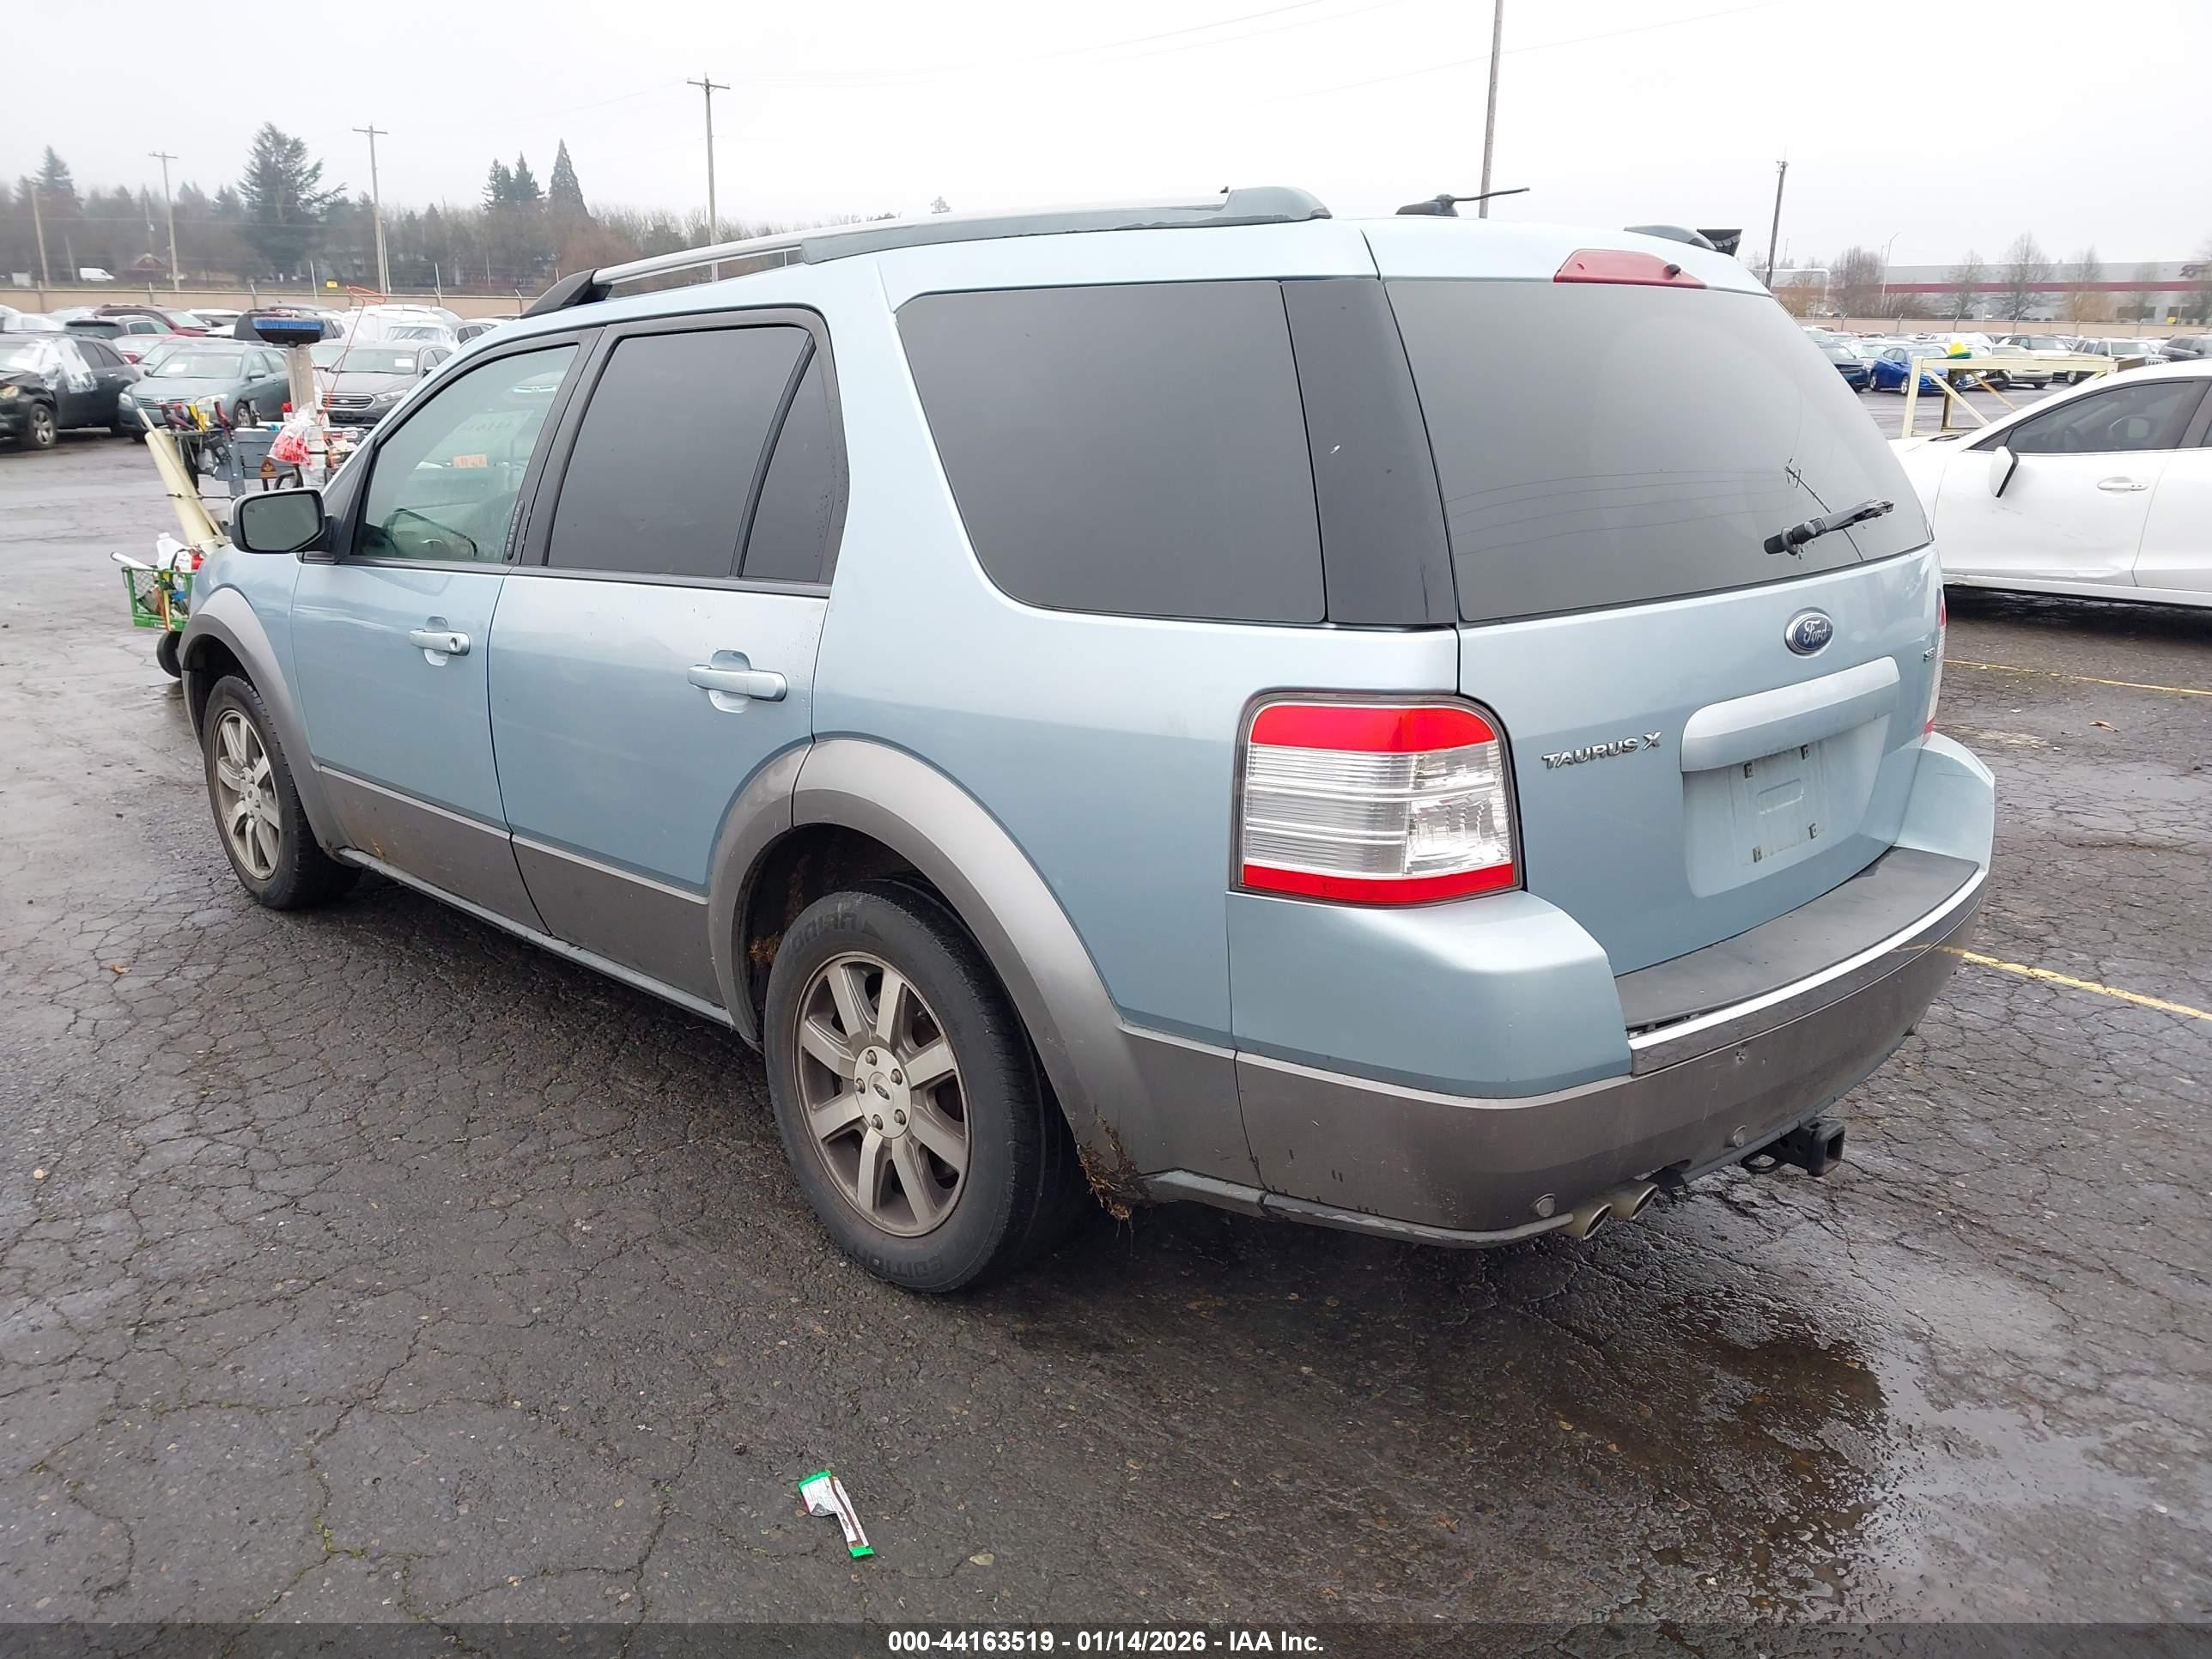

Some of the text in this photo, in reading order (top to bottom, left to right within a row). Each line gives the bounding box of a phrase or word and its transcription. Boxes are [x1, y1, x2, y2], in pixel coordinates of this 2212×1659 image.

[1803, 619, 1828, 644] Ford
[1541, 730, 1662, 769] TAURUS X
